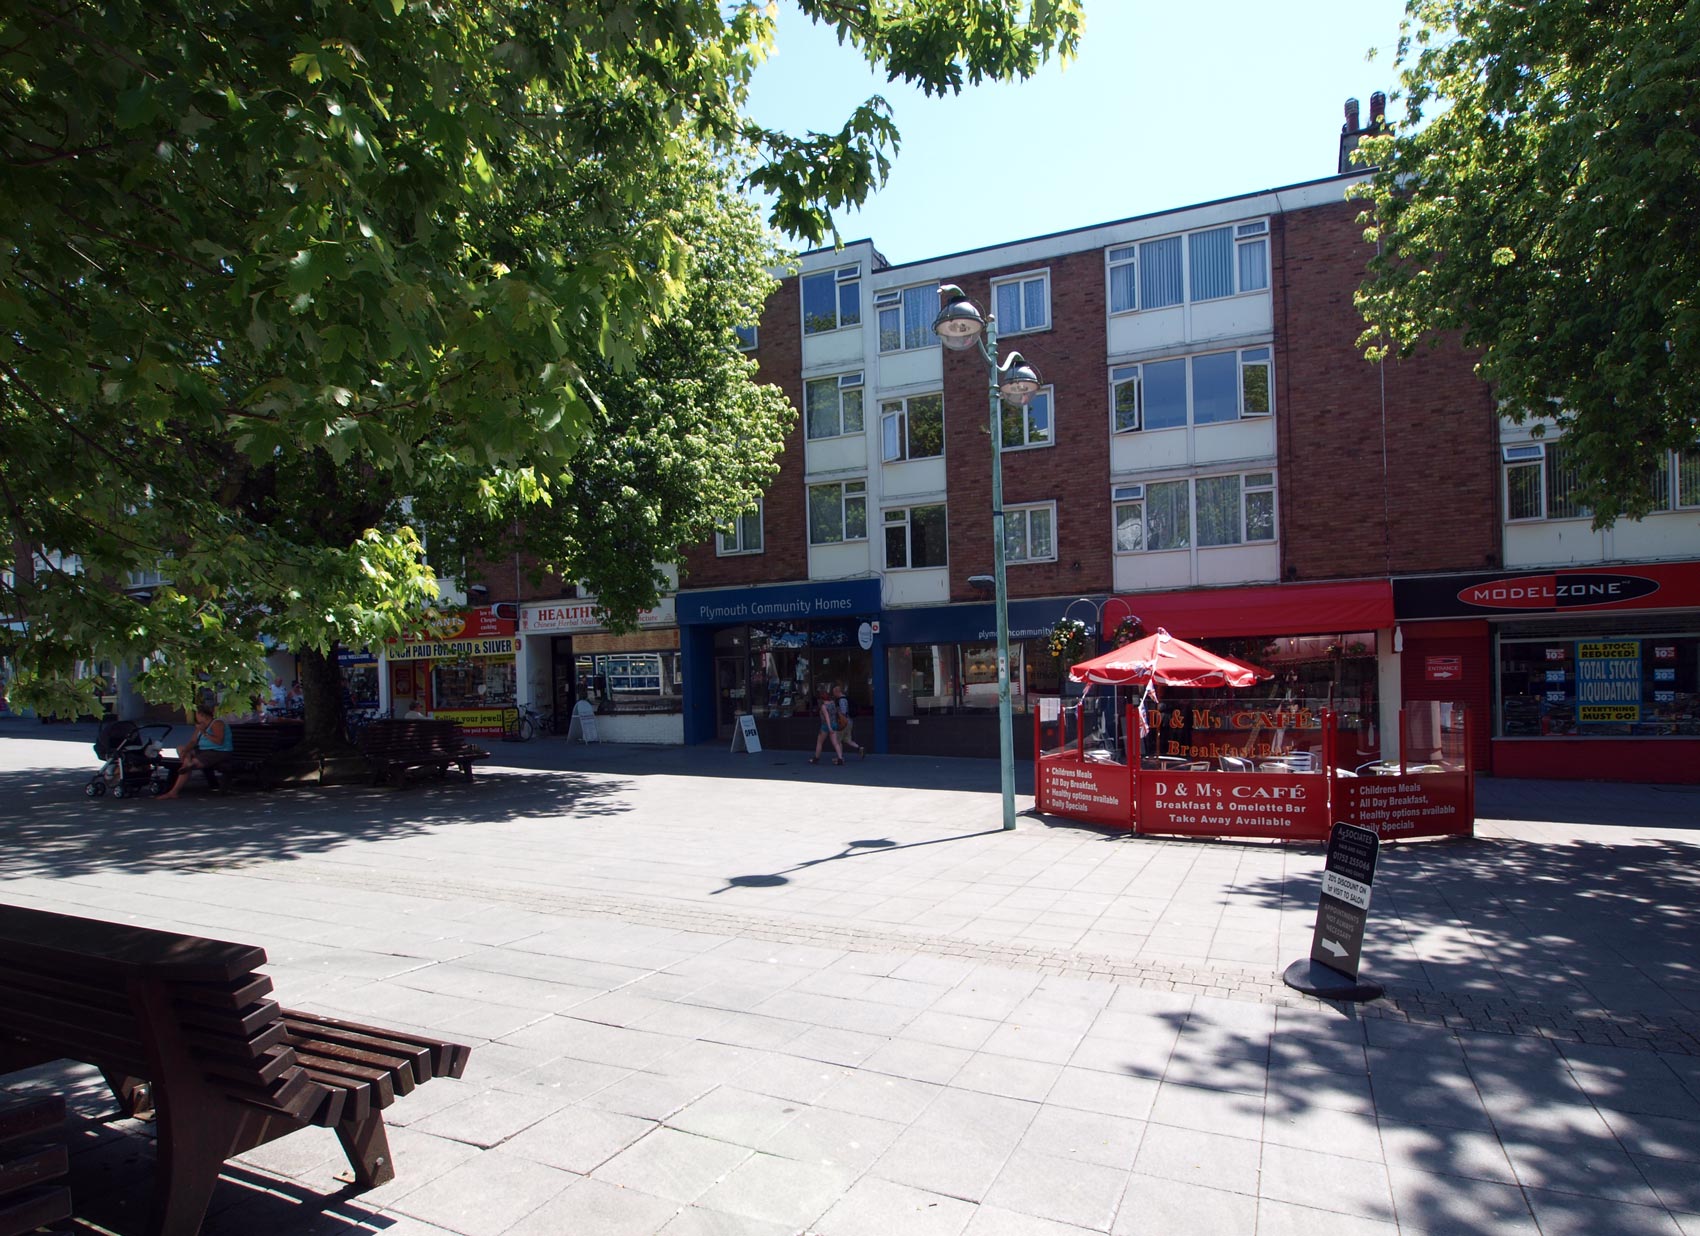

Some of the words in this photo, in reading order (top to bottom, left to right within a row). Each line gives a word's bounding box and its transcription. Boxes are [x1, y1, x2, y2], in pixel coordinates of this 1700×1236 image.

[1474, 583, 1621, 600] MODELZONE
[700, 604, 748, 620] Plymouth
[751, 600, 811, 613] Community
[815, 598, 852, 610] Homes
[533, 621, 556, 629] Chinese
[558, 618, 578, 627] Herbal
[413, 645, 431, 657] PAID
[475, 643, 482, 654] &
[483, 640, 512, 653] SILVER
[1582, 650, 1635, 658] REDUCED!
[1579, 661, 1606, 680] TOTAL
[1609, 660, 1638, 679] STOCK
[1579, 681, 1639, 703] LIQUIDATION
[1148, 709, 1162, 729] D
[1170, 709, 1184, 729] &
[1232, 707, 1313, 729] CAFÉ
[1167, 740, 1256, 758] Breakfast
[1051, 767, 1075, 777] Childrens
[1076, 769, 1093, 779] Meals
[1060, 779, 1070, 789] Day
[1070, 780, 1098, 792] Breakfast,
[1155, 782, 1167, 796] D
[1174, 782, 1188, 796] &
[1231, 784, 1306, 800] CAFÉ
[1360, 785, 1396, 795] Childrens
[1398, 783, 1421, 793] Meals
[1051, 788, 1071, 800] Healthy
[1072, 791, 1092, 801] options
[1093, 795, 1119, 805] available
[1052, 798, 1064, 810] Daily
[1065, 800, 1088, 812] Specials
[1360, 798, 1371, 808] All
[1372, 797, 1387, 808] Day
[1389, 794, 1429, 806] Breakfast,
[1155, 800, 1211, 810] Breakfast
[1216, 802, 1224, 810] &
[1229, 802, 1283, 812] Omelette
[1285, 804, 1306, 813] Bar
[1360, 809, 1390, 821] Healthy
[1392, 807, 1420, 819] options
[1422, 804, 1456, 815] available
[1169, 814, 1196, 823] Take
[1200, 815, 1231, 826] Away
[1235, 816, 1291, 827] Available
[1382, 820, 1415, 832] Specials
[1332, 851, 1348, 863] 01752
[1328, 873, 1337, 883] 20%
[1337, 877, 1359, 891] DISCOUNT
[1359, 886, 1367, 894] ON
[1333, 886, 1343, 896] VISIT
[1344, 890, 1350, 899] TO
[1350, 893, 1364, 905] SALON
[1324, 903, 1359, 924] APPOINTMENTS
[1326, 913, 1336, 923] NOT
[1336, 919, 1354, 933] ALWAYS
[1326, 923, 1352, 941] NECESSARY
